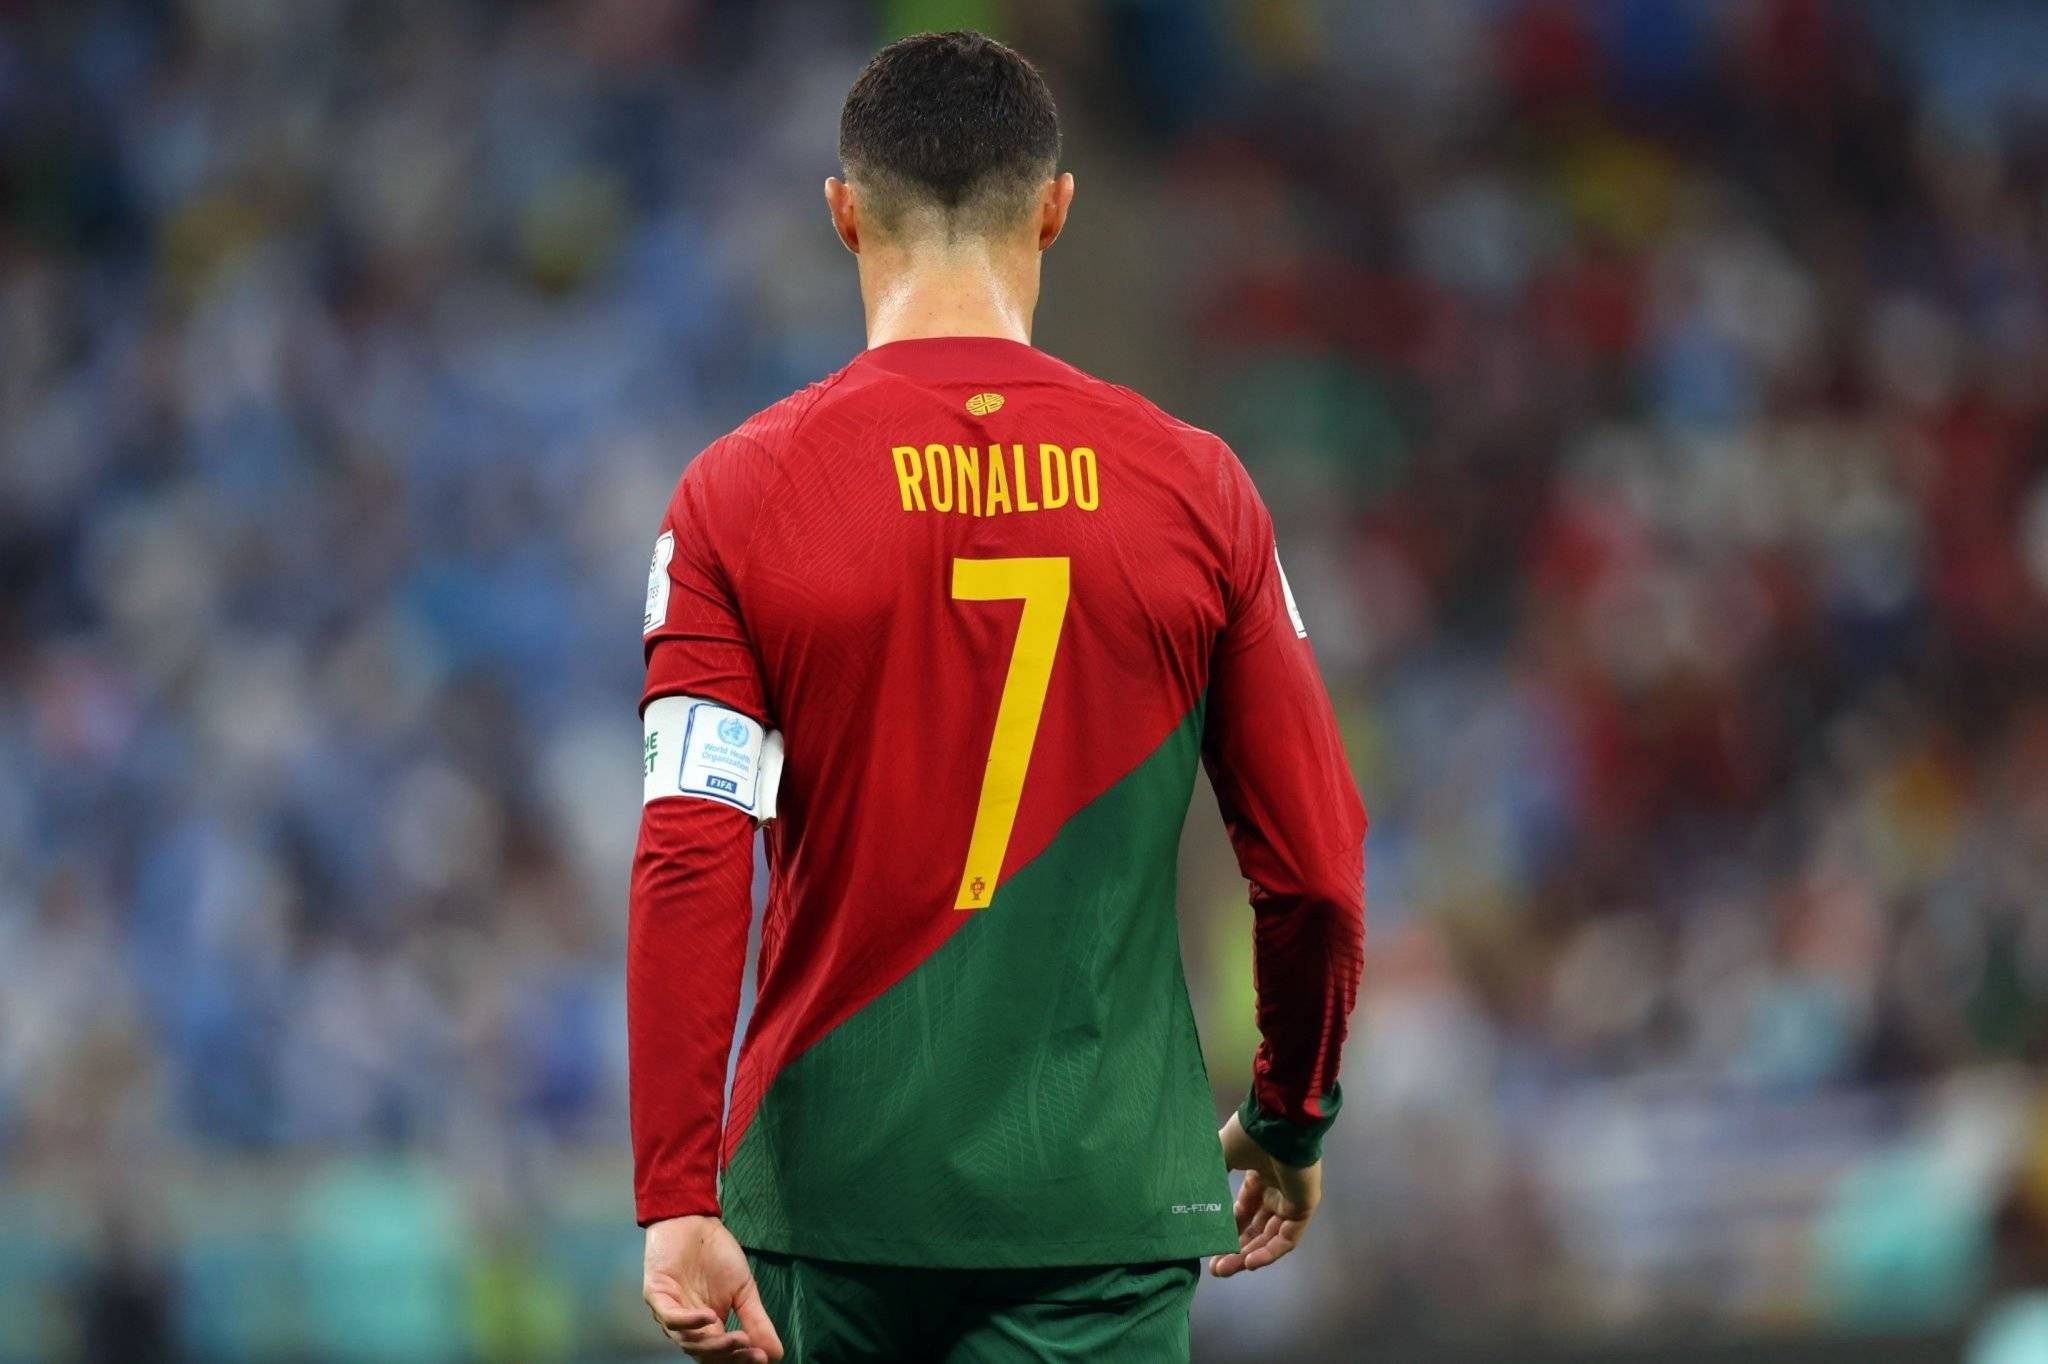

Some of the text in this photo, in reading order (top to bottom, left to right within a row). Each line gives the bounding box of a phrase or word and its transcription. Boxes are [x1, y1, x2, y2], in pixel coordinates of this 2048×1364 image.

[892, 443, 1099, 517] RONALDO
[951, 557, 1070, 910] 7
[703, 742, 729, 755] World
[702, 751, 751, 773] Organization
[709, 777, 733, 791] FIFA
